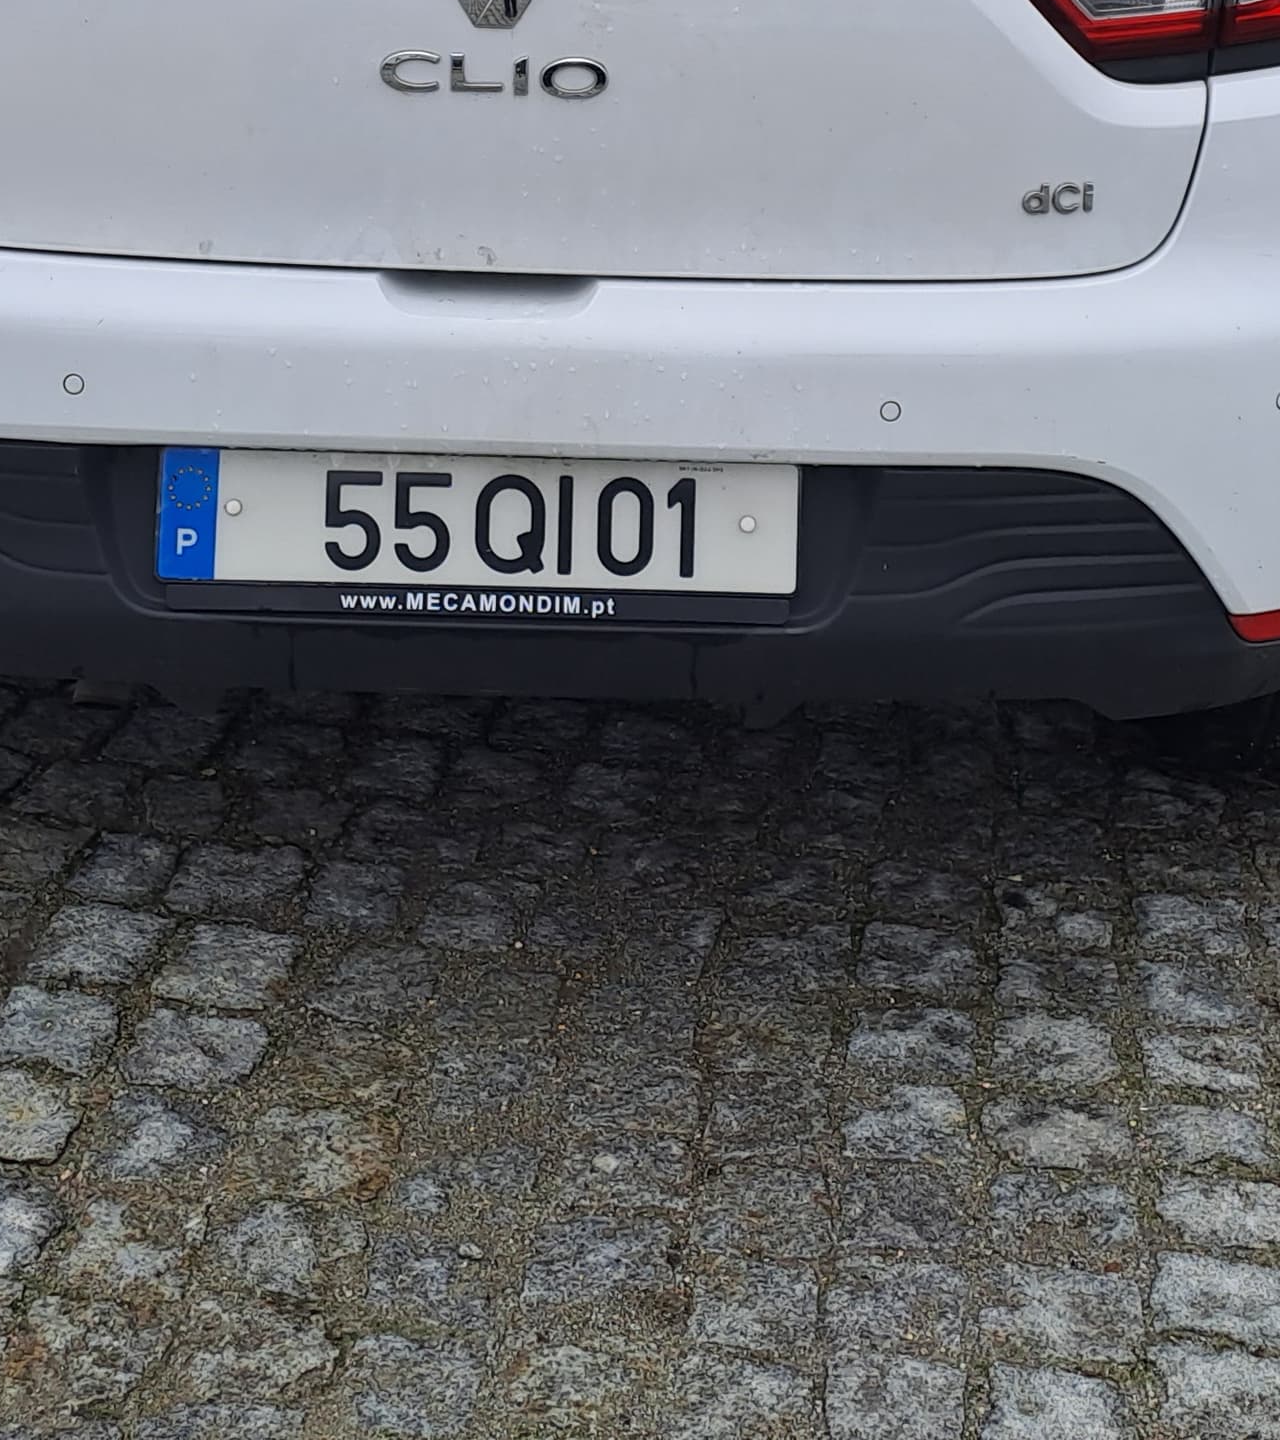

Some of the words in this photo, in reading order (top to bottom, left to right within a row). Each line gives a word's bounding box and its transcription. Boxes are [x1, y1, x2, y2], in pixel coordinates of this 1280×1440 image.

[380, 50, 609, 99] CLIO
[176, 527, 198, 556] P
[340, 592, 616, 618] www.MECAMONDIM.pt
